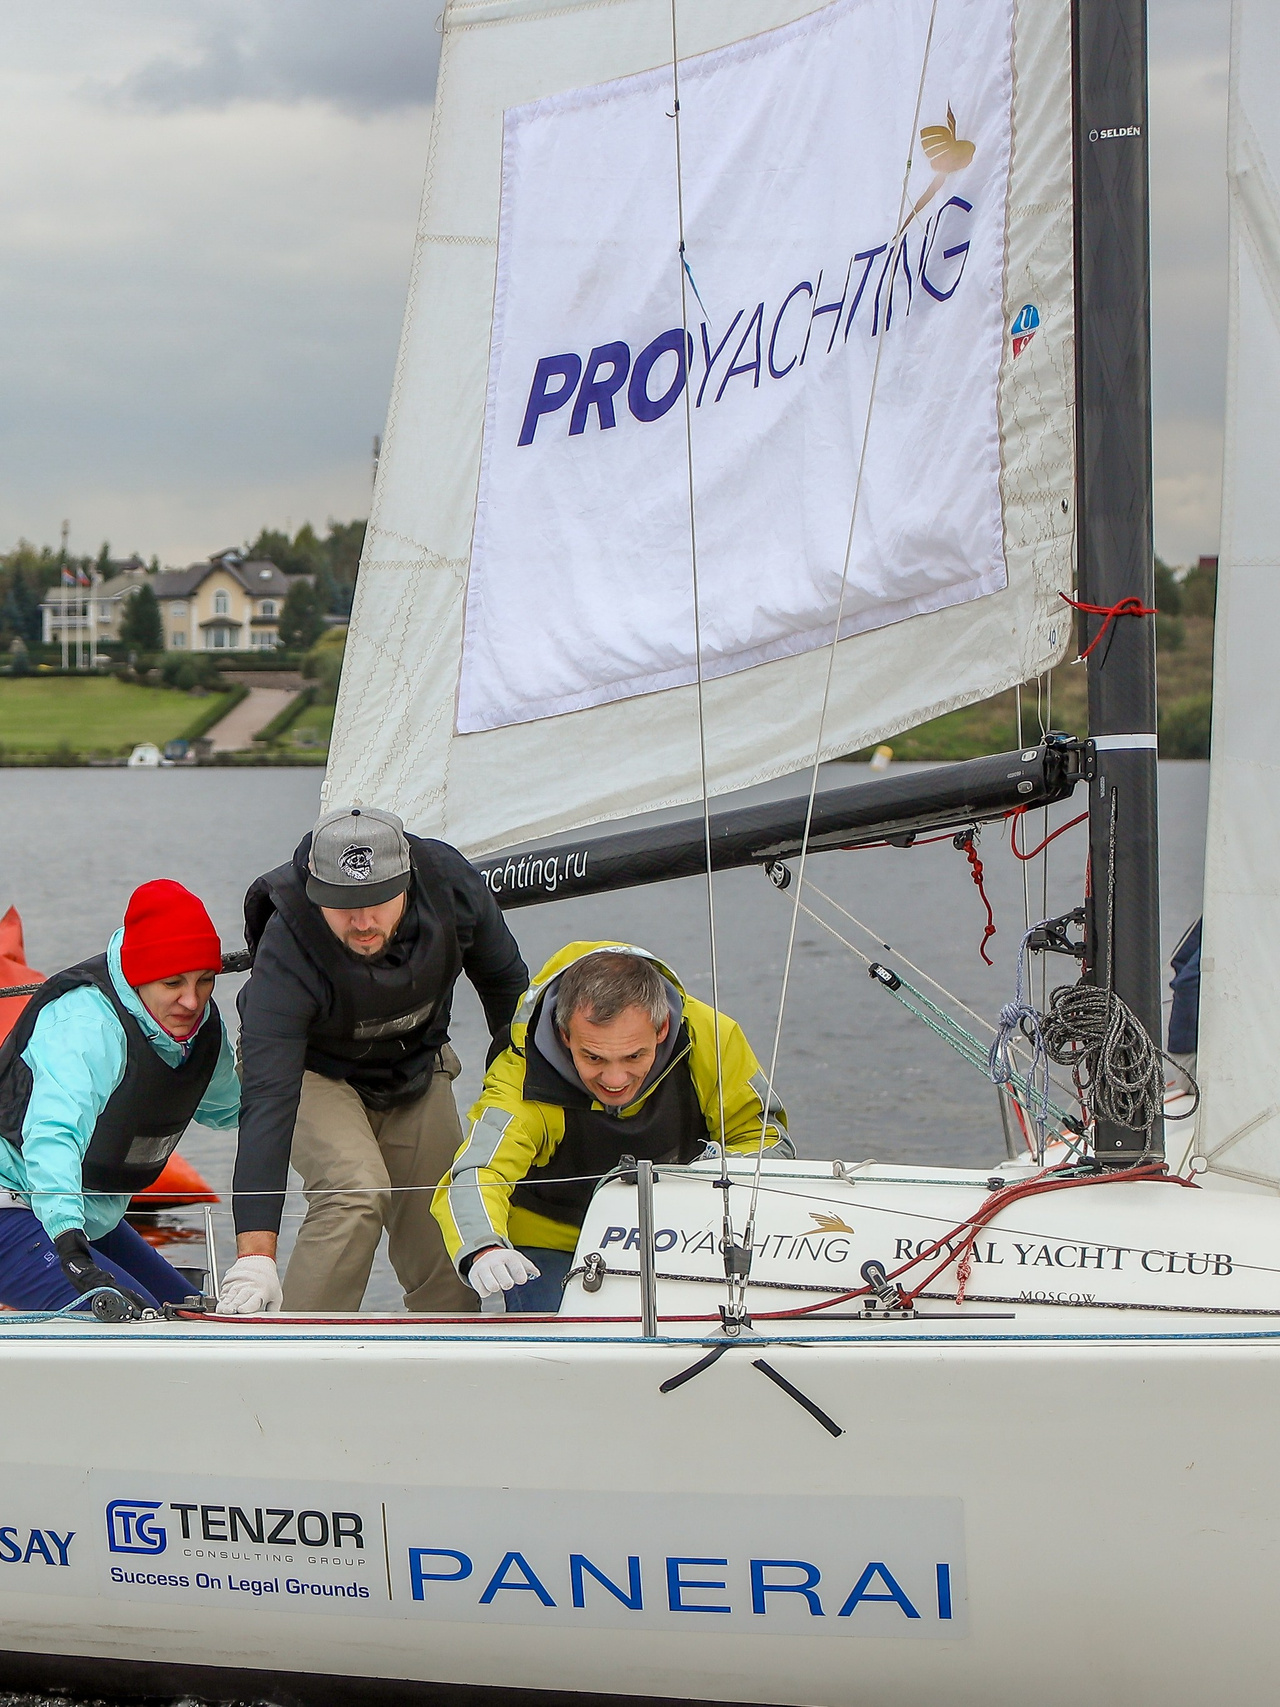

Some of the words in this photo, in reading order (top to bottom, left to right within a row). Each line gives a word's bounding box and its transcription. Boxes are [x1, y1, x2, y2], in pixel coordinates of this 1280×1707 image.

[517, 196, 973, 447] PROYACHTING
[480, 851, 589, 892] achting.ru
[893, 1238, 1004, 1264] ROYAL
[1013, 1243, 1131, 1270] YACHT
[1141, 1250, 1233, 1277] CLUB
[1019, 1290, 1096, 1303] MOSCOW
[170, 1503, 365, 1549] TENZOR
[183, 1549, 295, 1563] CONSULTING
[308, 1556, 367, 1566] GROUP
[111, 1567, 190, 1587] Success
[196, 1573, 221, 1589] On
[228, 1575, 280, 1595] Legal
[286, 1578, 370, 1598] Grounds
[408, 1547, 952, 1620] PANERAI
